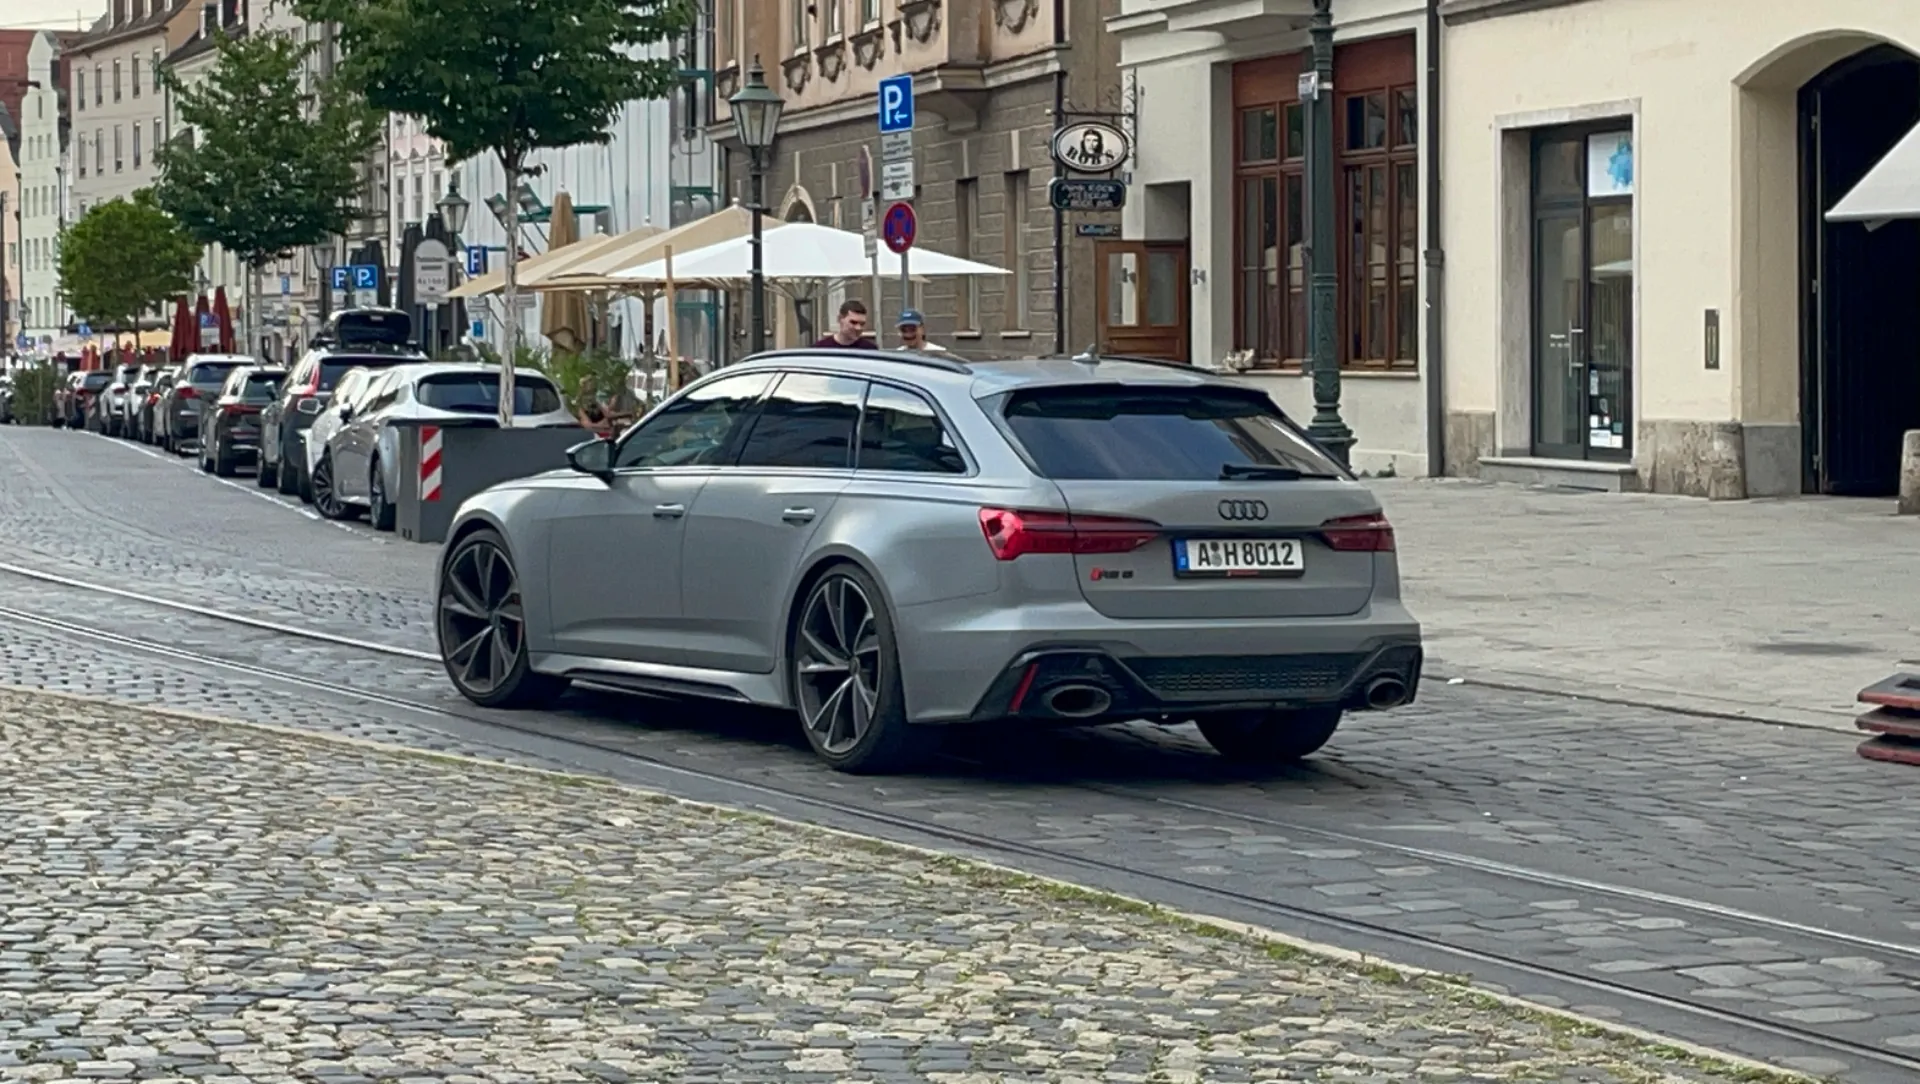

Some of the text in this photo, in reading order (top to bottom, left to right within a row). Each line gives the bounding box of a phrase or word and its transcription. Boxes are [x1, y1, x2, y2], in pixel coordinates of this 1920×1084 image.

[883, 85, 903, 125] P
[357, 268, 370, 287] P
[1198, 542, 1211, 567] A
[1242, 541, 1295, 567] 8012
